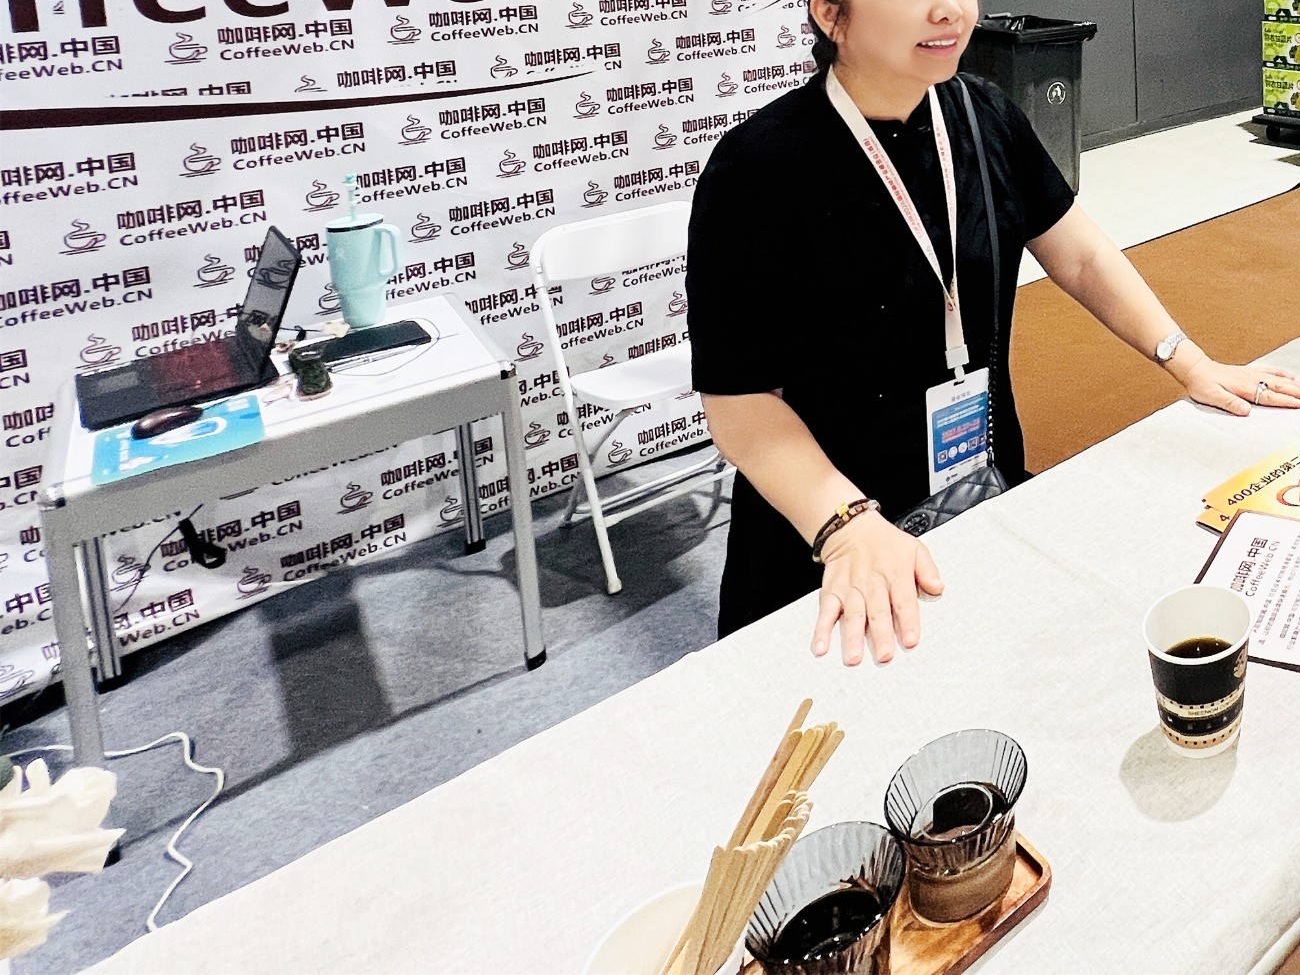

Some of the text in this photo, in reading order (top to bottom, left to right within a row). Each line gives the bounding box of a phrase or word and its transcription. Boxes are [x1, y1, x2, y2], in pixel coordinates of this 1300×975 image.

[429, 5, 538, 28] 咖啡网.中国
[600, 9, 688, 26] CoffeeWeb.CN
[217, 19, 353, 45] 咖啡网.中国
[431, 24, 539, 43] CoffeeWeb.CN
[675, 28, 755, 49] 咖啡网.中国
[219, 39, 355, 61] CoffeeWeb.CN
[524, 43, 621, 66] 咖啡网.中国
[676, 45, 756, 62] CoffeeWeb.CN
[338, 60, 456, 89] 咖啡网.中国
[606, 78, 693, 101] 咖啡网.中国
[439, 98, 545, 126] 咖啡网.中国
[607, 94, 694, 115] CoffeeWeb.CN
[231, 122, 364, 155] 咖啡网.中国
[440, 116, 547, 140] CoffeeWeb.CN
[233, 143, 366, 171] CoffeeWeb.CN
[533, 130, 628, 159] 咖啡网.中国
[534, 147, 630, 173] CoffeeWeb.CN
[117, 189, 264, 229] 咖啡网.中国
[449, 189, 554, 223] 咖啡网.中国
[120, 211, 266, 246] CoffeeWeb.CN
[451, 207, 555, 237] CoffeeWeb.CN
